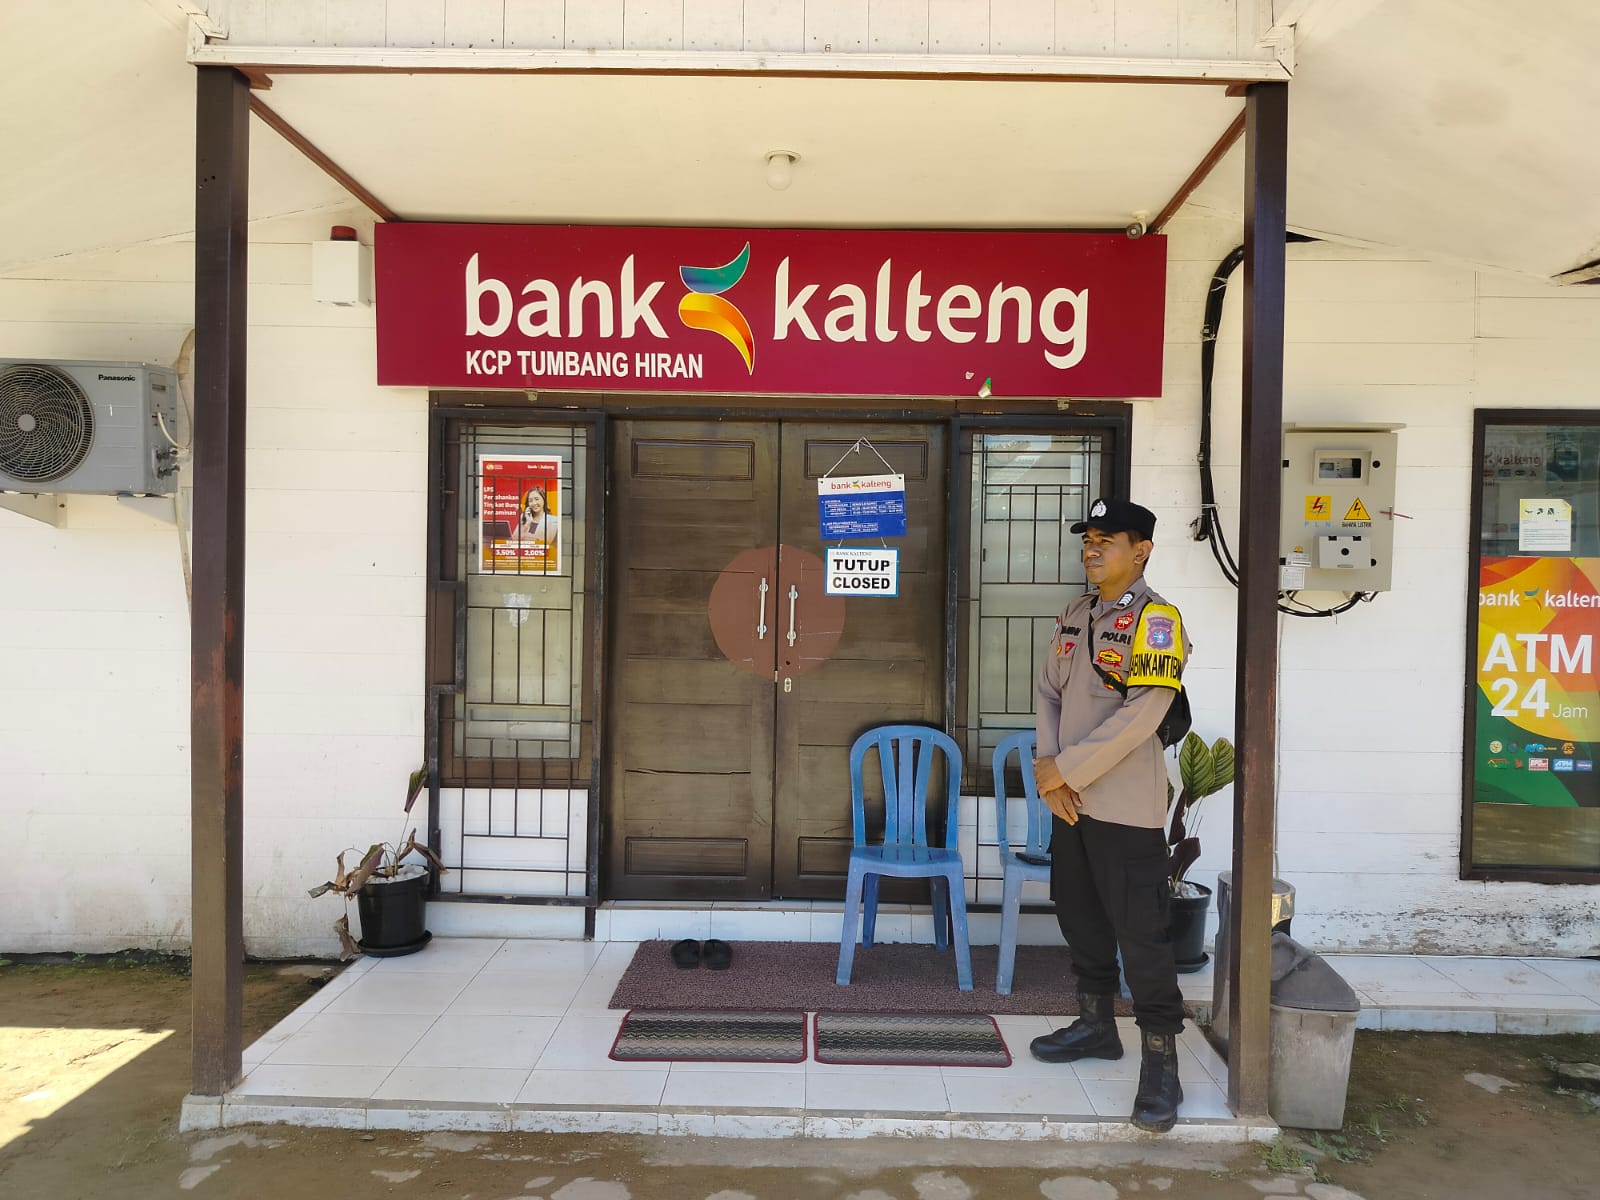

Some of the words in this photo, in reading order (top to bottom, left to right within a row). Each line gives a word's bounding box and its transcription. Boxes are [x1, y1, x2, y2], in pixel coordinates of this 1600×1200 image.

[466, 253, 669, 338] bank
[773, 257, 1089, 369] kalteng
[466, 350, 512, 375] KCP
[517, 351, 629, 377] TUMBANG
[635, 353, 703, 379] HIRAN
[98, 374, 136, 382] Panasonic
[831, 482, 851, 490] bank
[861, 480, 892, 489] kalteng
[833, 559, 890, 572] TUTUP
[833, 577, 890, 589] CLOSED
[1100, 631, 1132, 646] POLRI
[1482, 633, 1593, 674] ATM
[1491, 677, 1550, 718] 24
[1552, 703, 1588, 718] Jam
